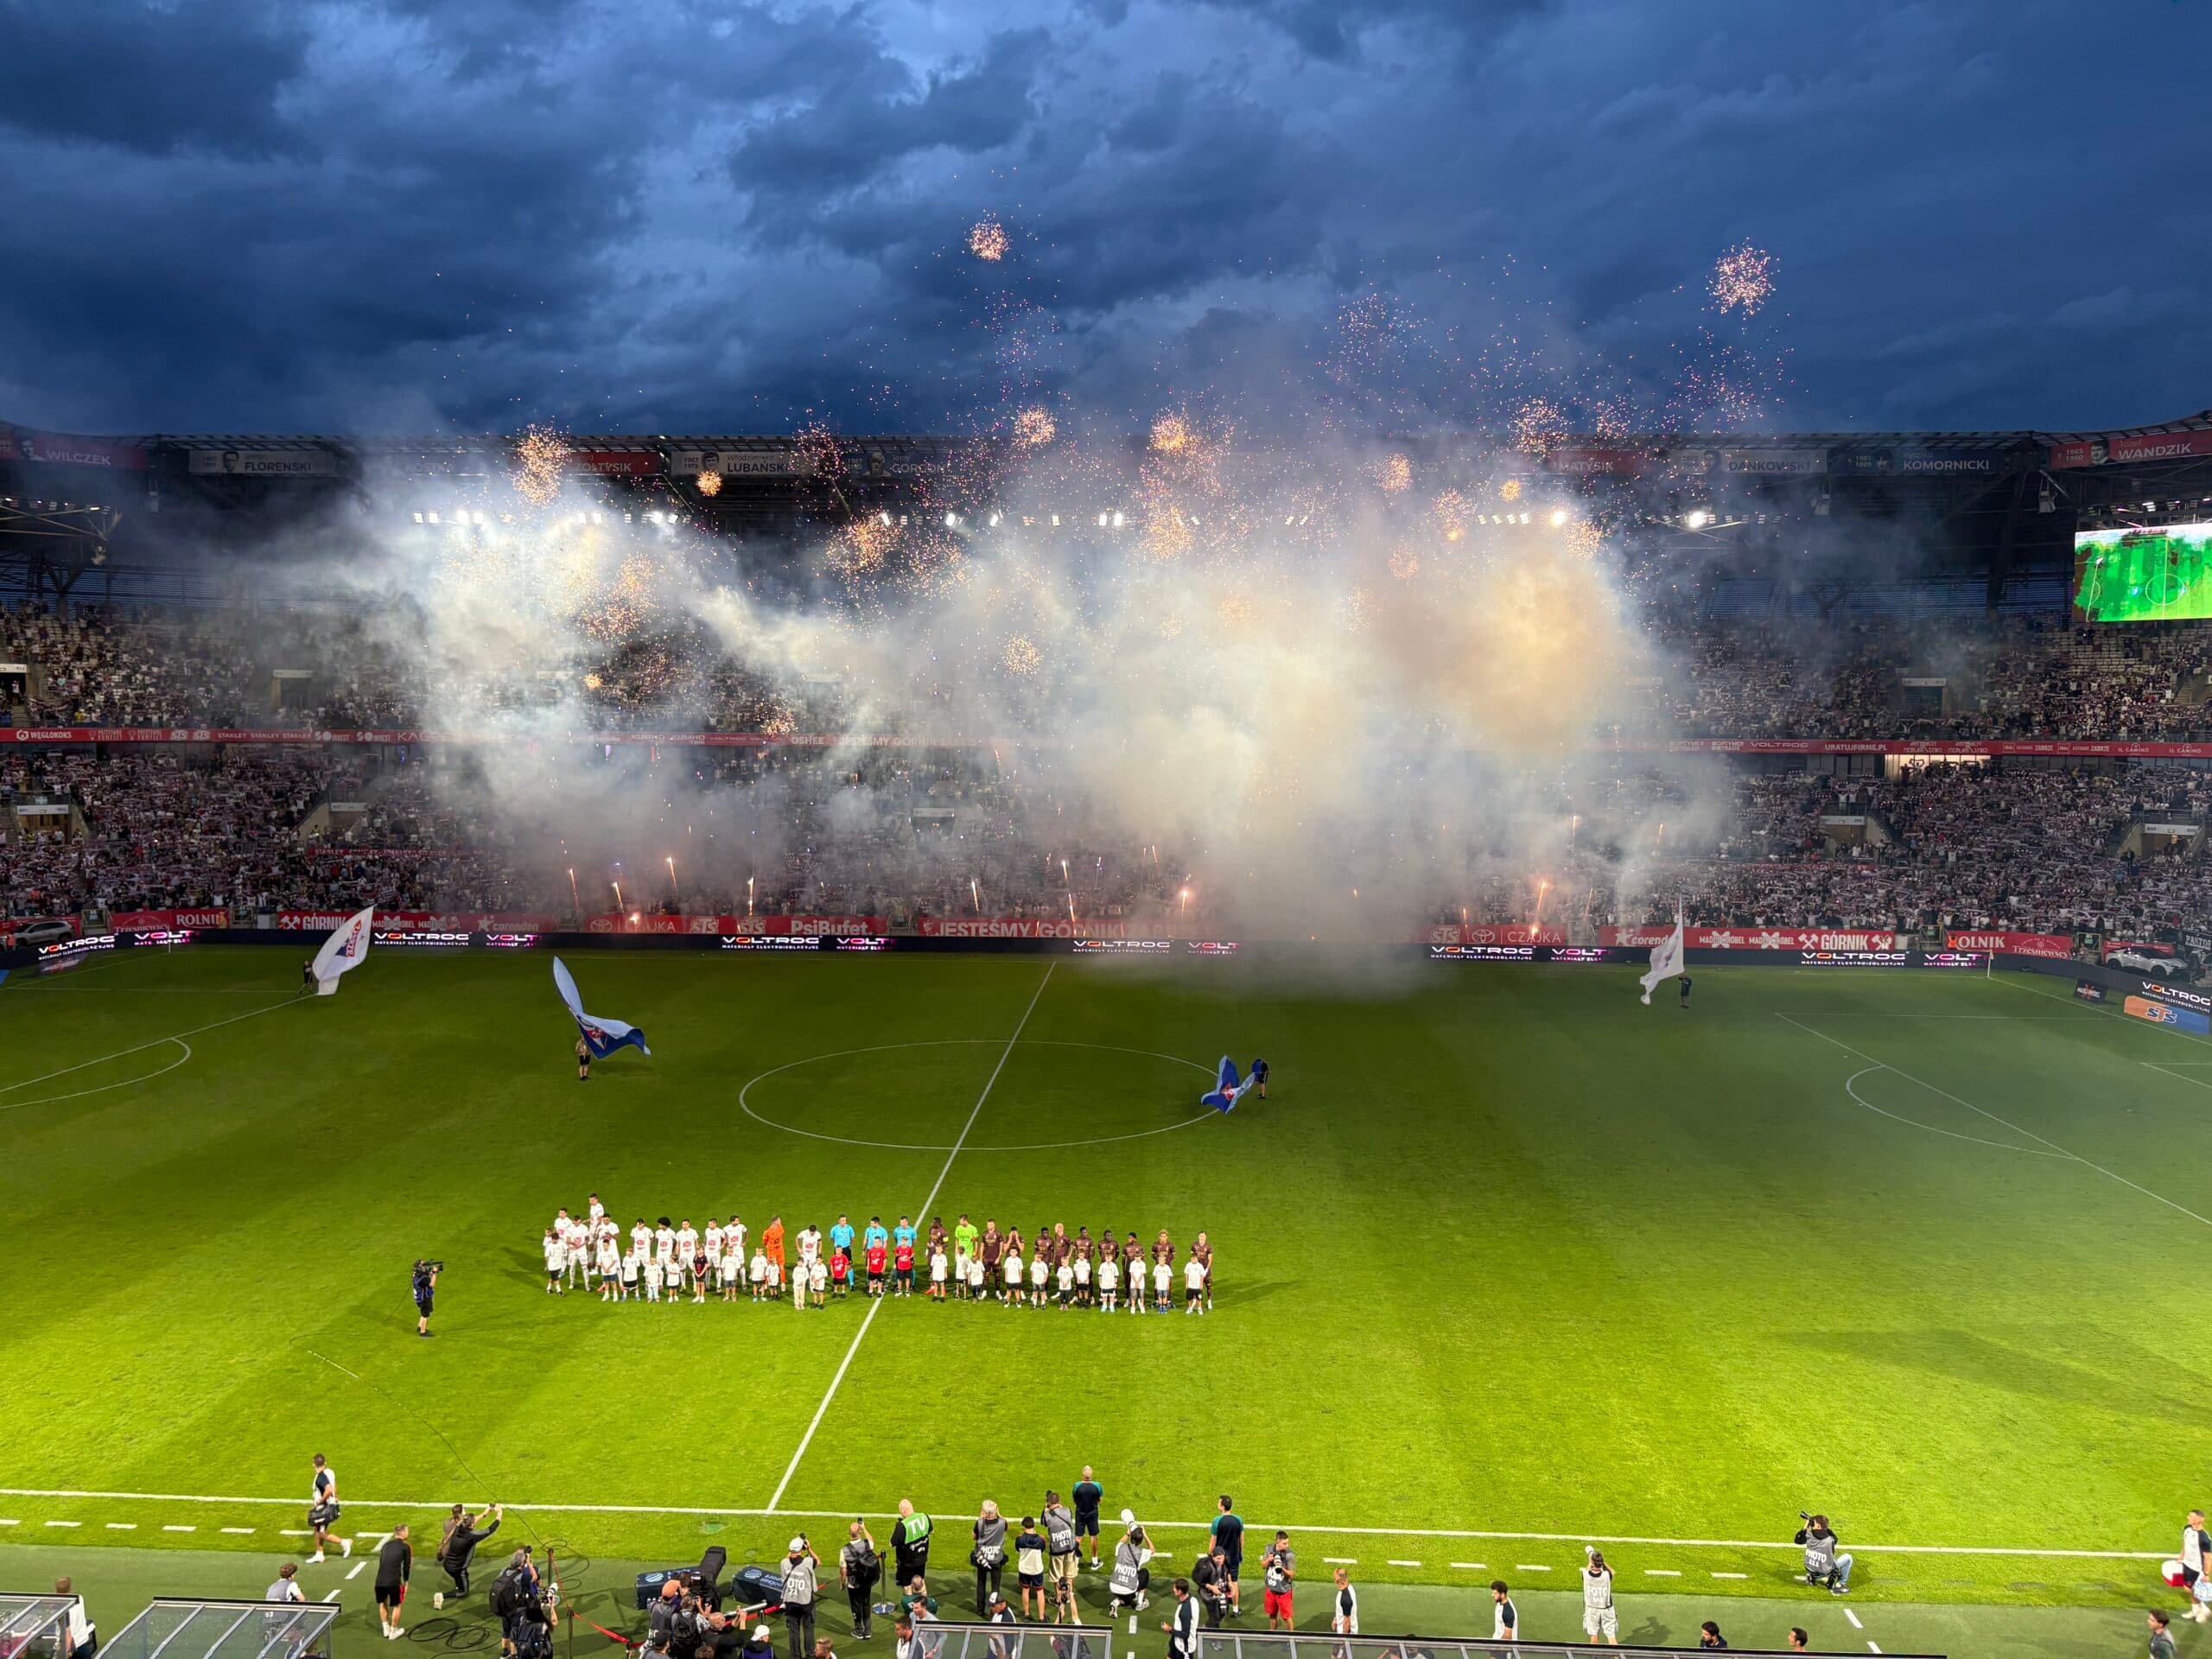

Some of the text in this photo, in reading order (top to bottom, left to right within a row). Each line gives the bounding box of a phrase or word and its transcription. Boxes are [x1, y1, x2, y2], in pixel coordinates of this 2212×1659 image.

[2119, 442, 2192, 460] WANDZIK
[46, 449, 111, 466] WILCZEK
[245, 462, 311, 472] FLORENSKI
[1729, 461, 1810, 471] DANKOWSKI
[1904, 460, 1990, 471] KOMORNICKI
[170, 730, 188, 741] STS
[193, 730, 210, 741] STS
[791, 736, 824, 746] OSHEE
[176, 915, 221, 926] ROLNI
[493, 921, 540, 931] corendon
[690, 916, 720, 933] STS
[740, 916, 767, 934] STS
[935, 919, 1031, 938] JESTEŚMY
[1430, 925, 1460, 944] STS
[1508, 932, 1562, 944] CZAJKA
[1631, 935, 1671, 944] corend
[1821, 931, 1869, 950] GÓRNIK
[1951, 936, 2005, 948] OLNIK
[38, 936, 116, 954] VOLTROG
[1432, 946, 1533, 955] VOLTROG
[2142, 981, 2211, 1007] VOLTROG
[2145, 1004, 2177, 1025] STS
[909, 1518, 926, 1535] TV
[1806, 1549, 1827, 1562] PHOTO
[1115, 1562, 1137, 1577] PHOTO
[785, 1580, 806, 1591] OTO
